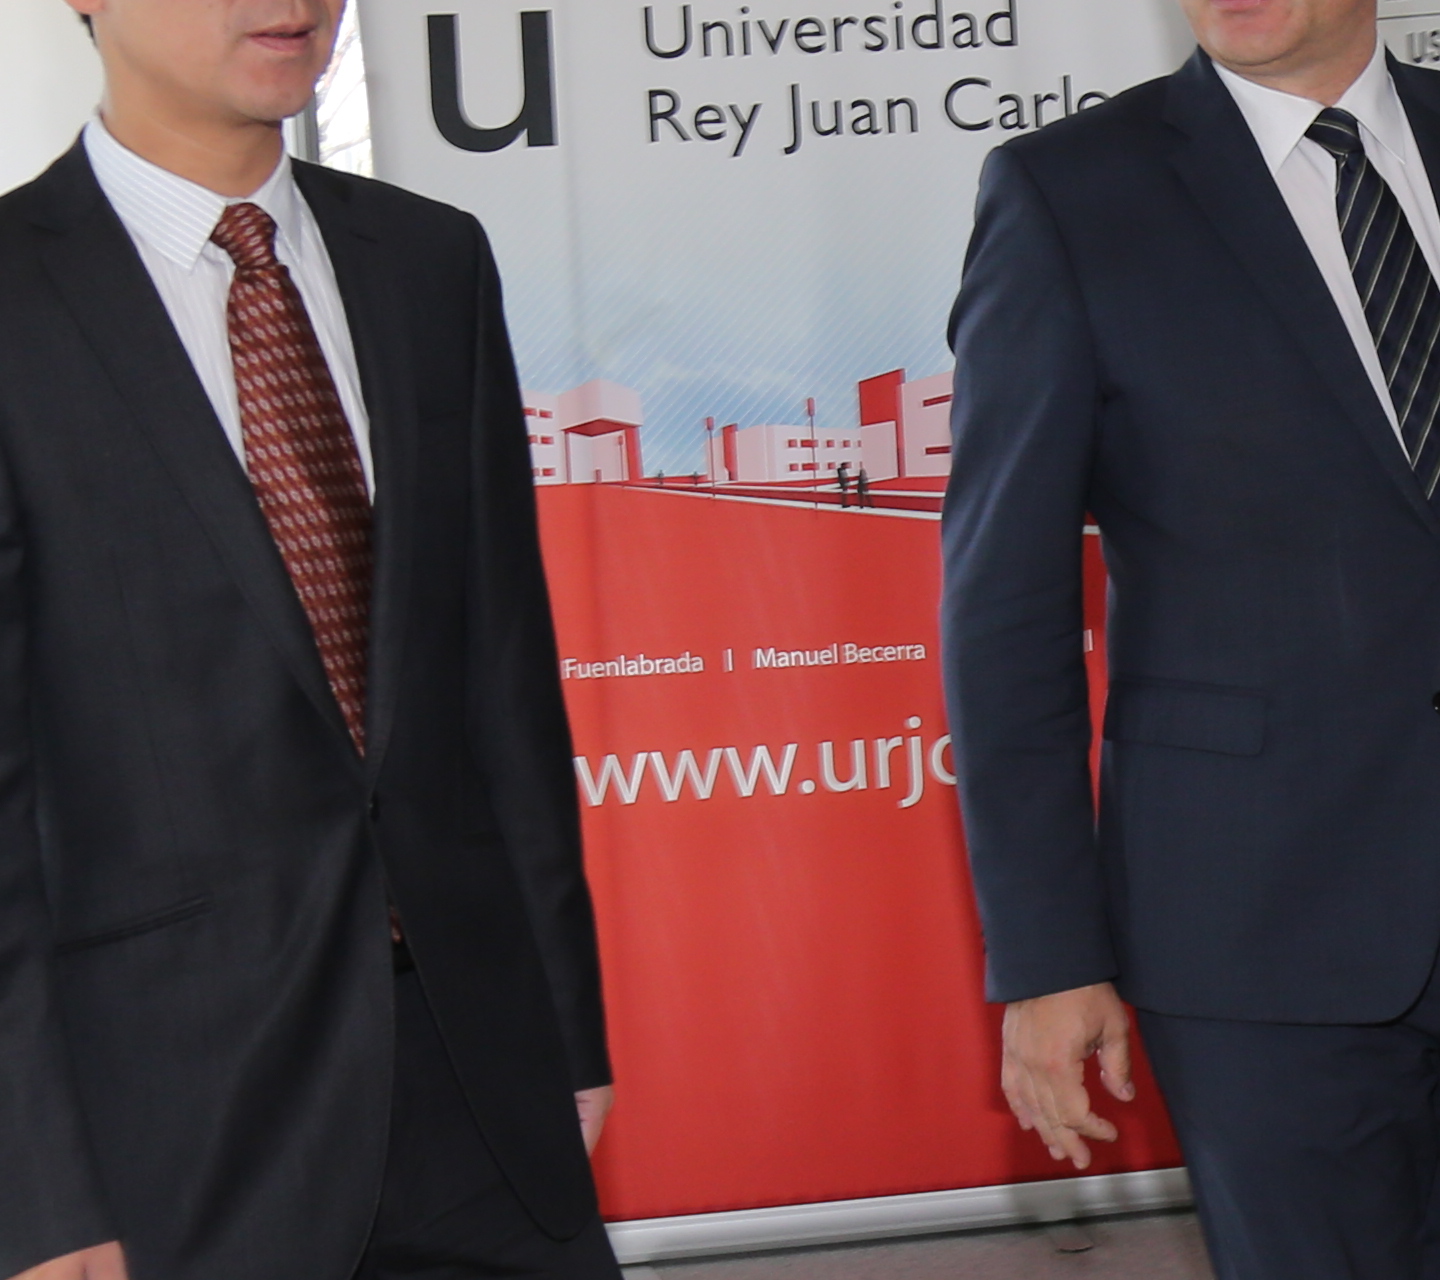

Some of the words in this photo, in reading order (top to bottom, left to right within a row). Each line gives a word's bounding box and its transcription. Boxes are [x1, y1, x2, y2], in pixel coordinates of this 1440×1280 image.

[647, 87, 763, 158] Rey
[783, 82, 920, 155] Juan
[944, 74, 1109, 131] Carlo
[561, 652, 704, 680] Fuenlabrada
[751, 644, 838, 669] Manuel
[842, 642, 926, 664] Becerra
